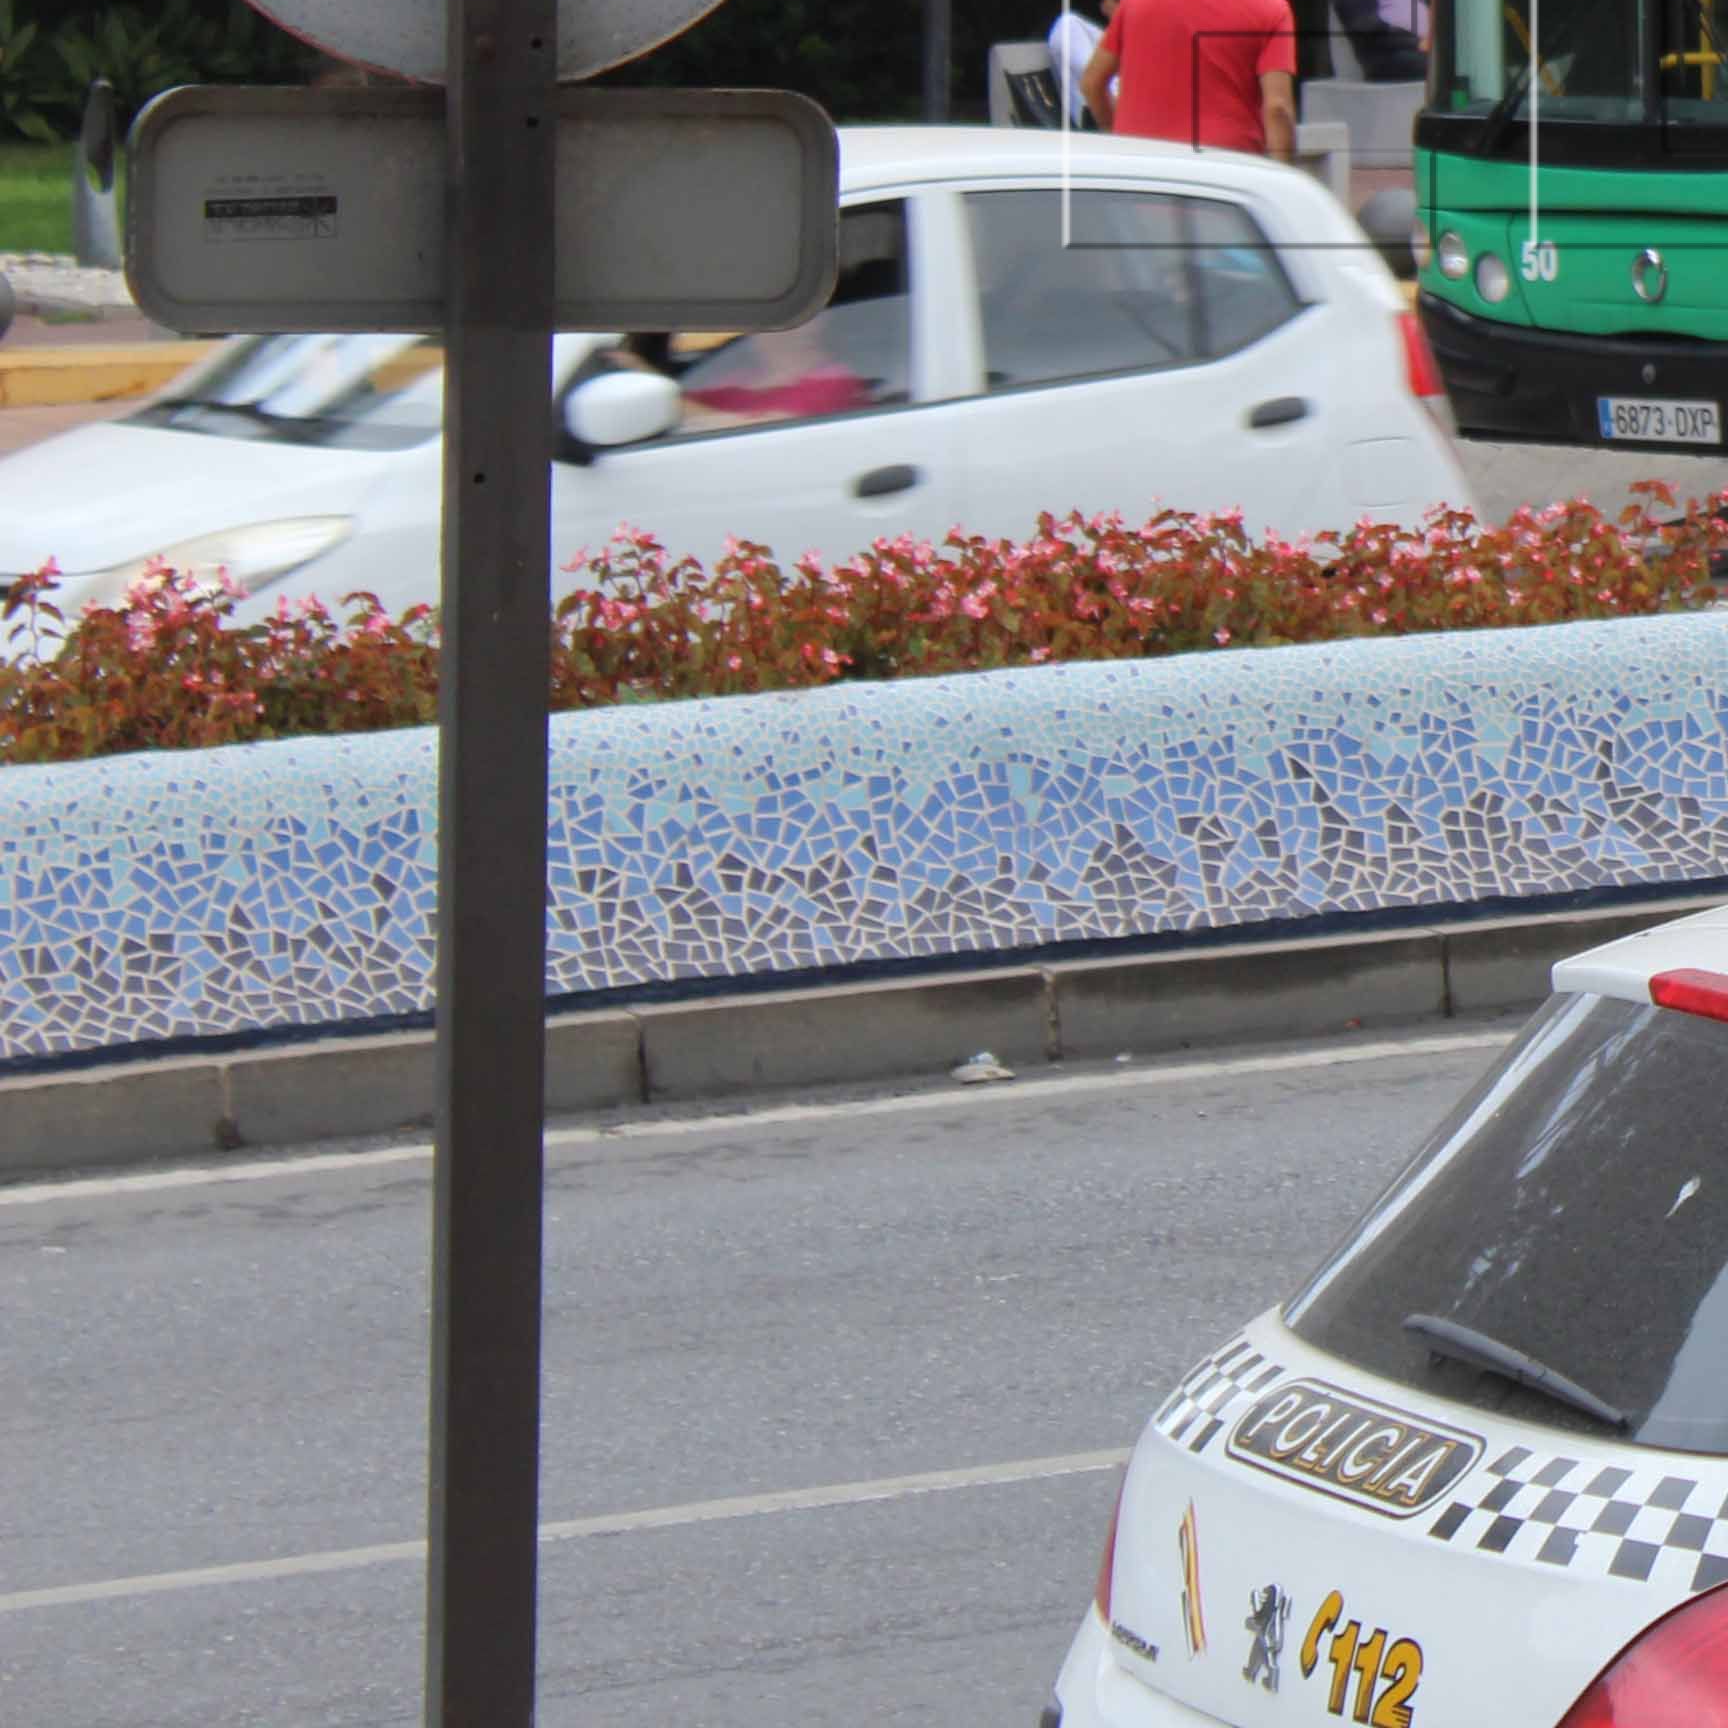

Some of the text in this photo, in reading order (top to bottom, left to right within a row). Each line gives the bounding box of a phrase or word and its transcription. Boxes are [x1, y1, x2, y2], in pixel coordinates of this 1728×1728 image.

[1520, 240, 1559, 282] 50
[1240, 1387, 1457, 1507] POLICIA
[1327, 1619, 1427, 1728] 112
